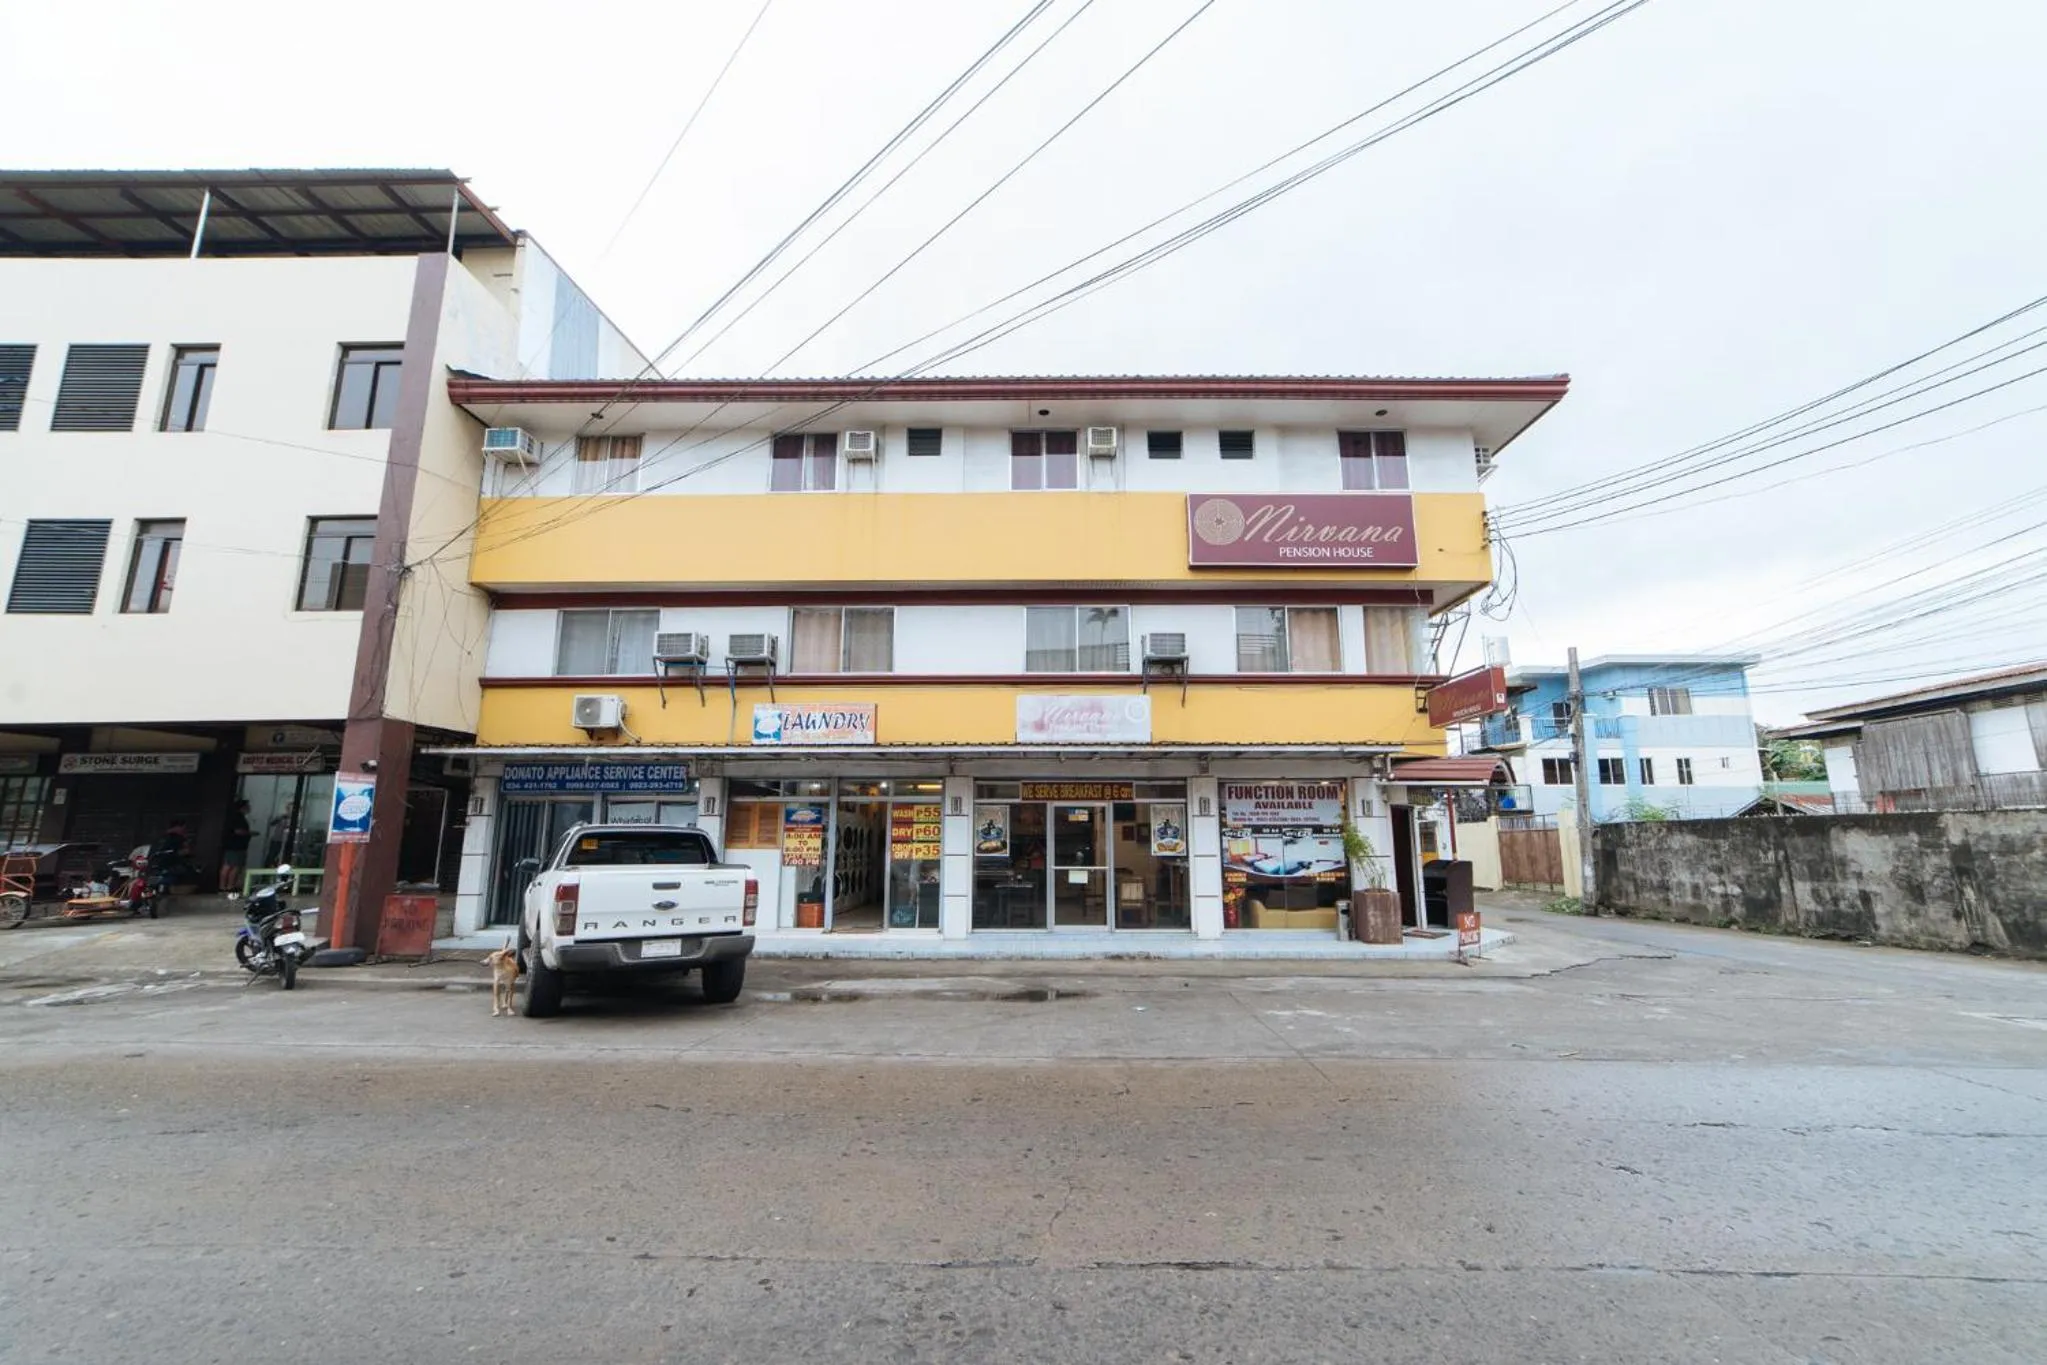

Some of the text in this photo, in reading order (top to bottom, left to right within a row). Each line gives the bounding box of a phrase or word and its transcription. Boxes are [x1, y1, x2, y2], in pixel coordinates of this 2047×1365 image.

[1244, 504, 1404, 543] Nirvana
[1279, 547, 1374, 558] PENSION HOUSE
[783, 711, 870, 732] LAUNDRY
[80, 755, 118, 765] STONE
[120, 755, 160, 765] SURGE
[504, 765, 687, 780] DONATO APPLIANCE SERVICE CENTER
[1060, 784, 1102, 798] BREAKFAST
[1227, 785, 1338, 800] FUNCTION ROOM
[1254, 801, 1314, 809] AVAILABLE
[893, 808, 914, 818] WASH
[892, 828, 913, 836] DRY
[584, 915, 736, 930] RANGER
[1463, 914, 1476, 928] NO
